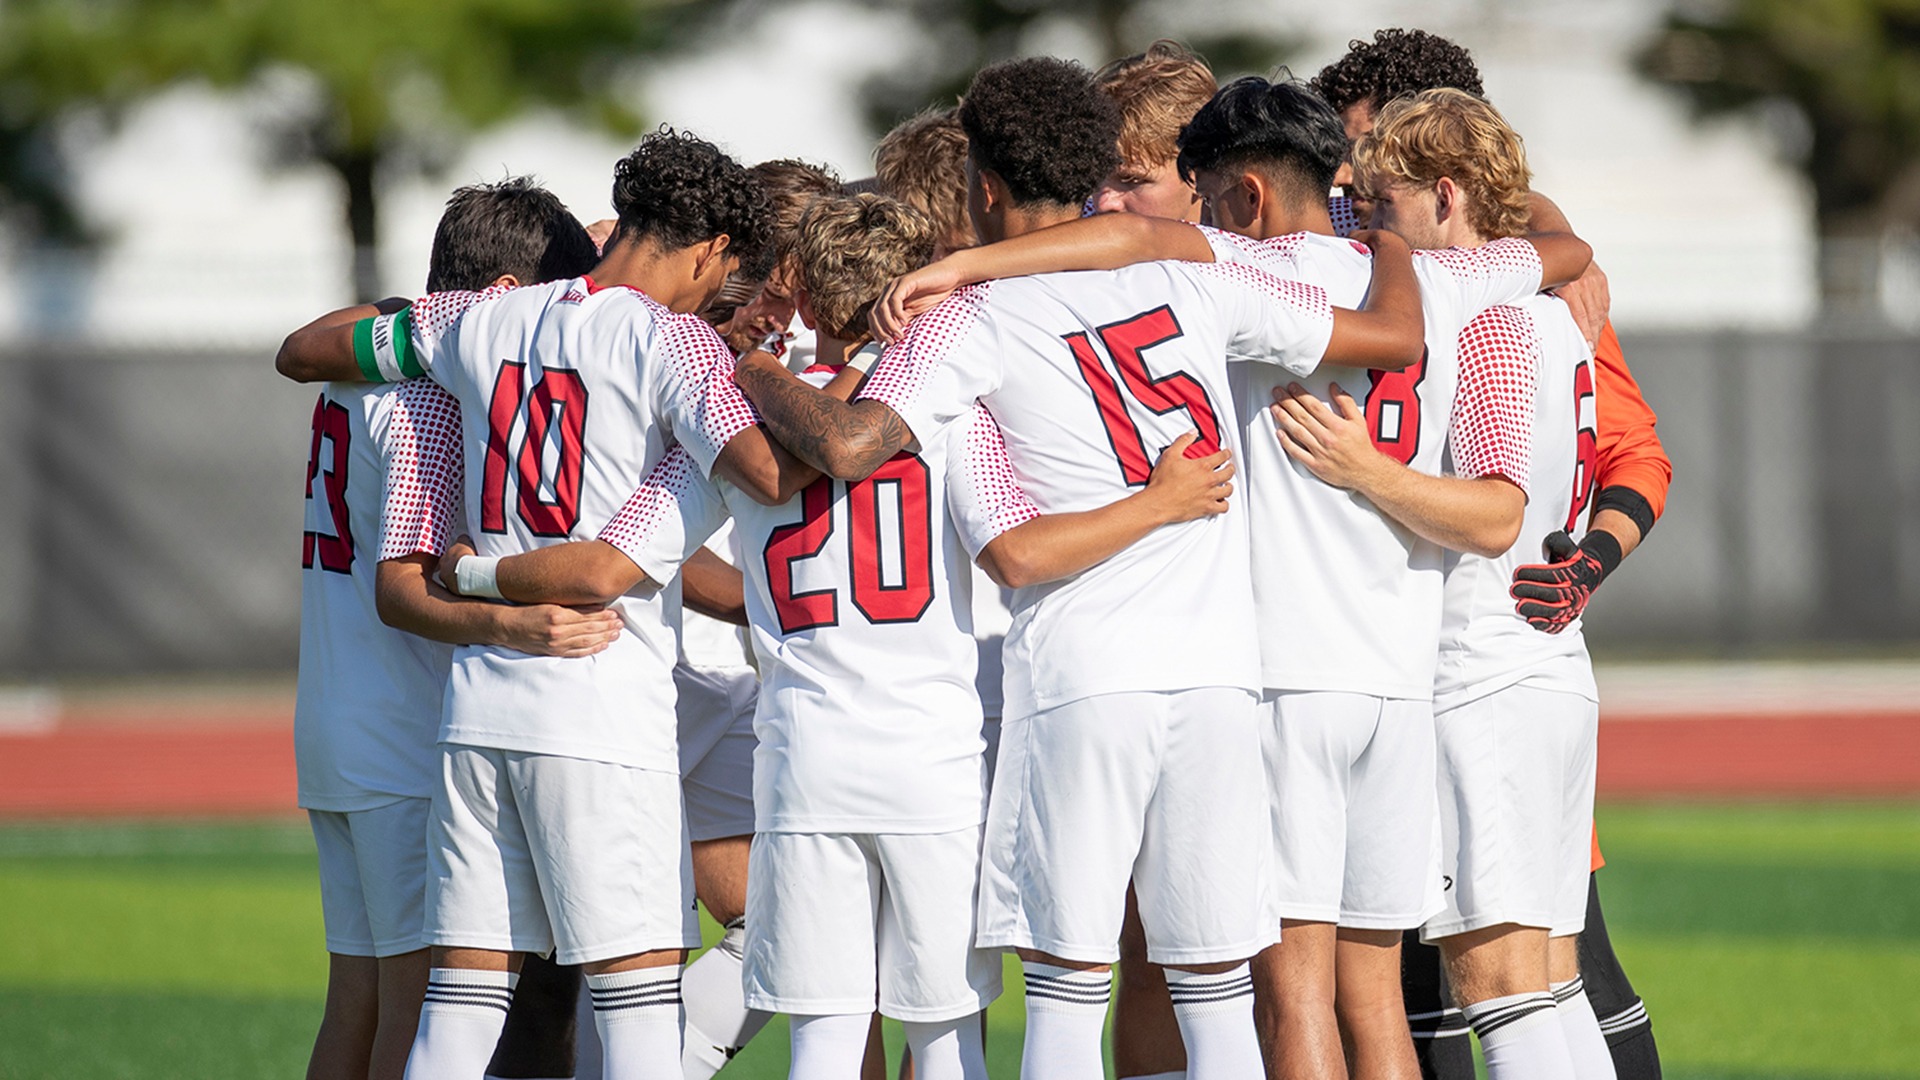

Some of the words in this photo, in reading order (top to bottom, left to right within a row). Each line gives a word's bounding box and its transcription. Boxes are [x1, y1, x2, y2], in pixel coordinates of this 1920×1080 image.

[481, 359, 589, 537] 10
[1060, 303, 1222, 488] 15
[1364, 342, 1429, 466] 8
[1564, 360, 1597, 535] 6
[763, 449, 935, 635] 20
